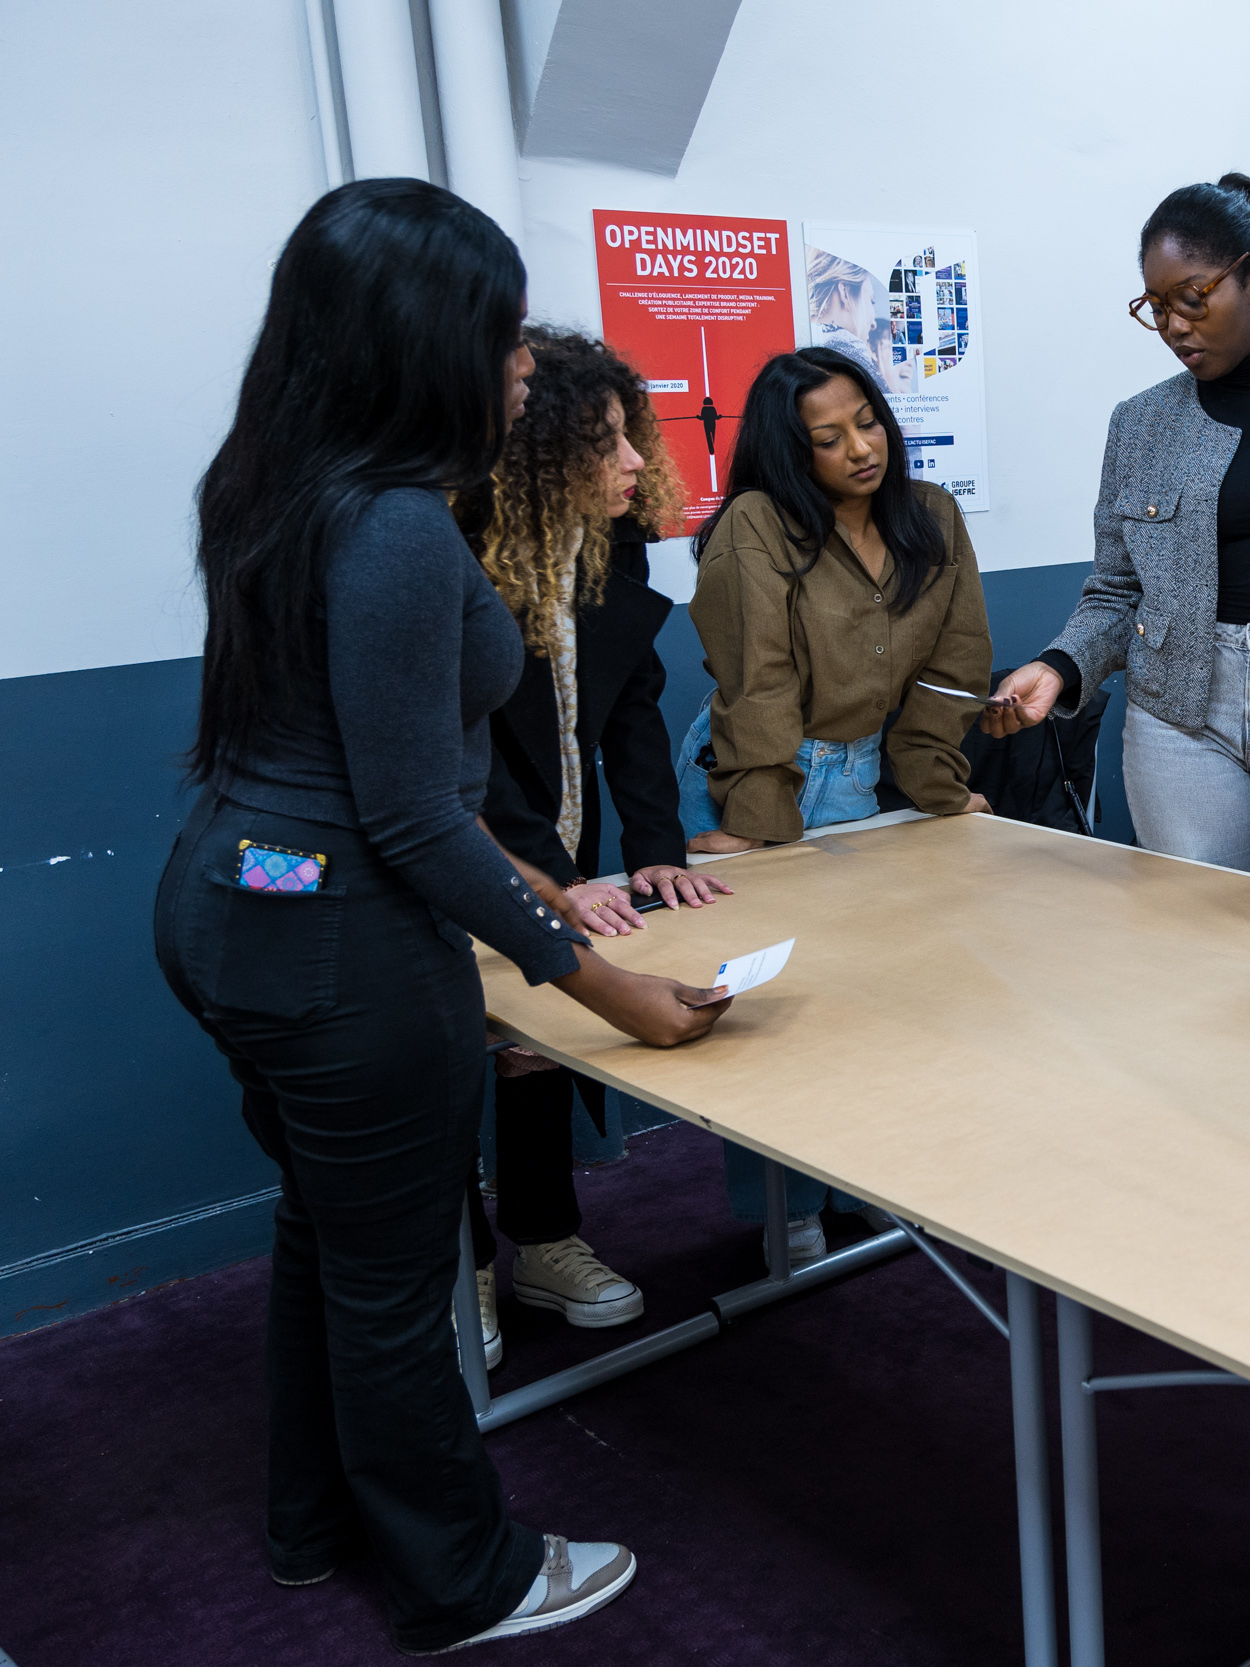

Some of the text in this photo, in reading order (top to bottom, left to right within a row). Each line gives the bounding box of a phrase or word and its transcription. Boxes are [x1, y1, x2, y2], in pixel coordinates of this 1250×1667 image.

[605, 224, 780, 255] OPENMINDSET
[635, 253, 758, 280] DAYS 2020
[650, 382, 669, 390] janvier
[906, 394, 949, 403] conférences
[904, 405, 940, 413] interviews
[951, 480, 976, 488] GROUPE
[951, 488, 976, 496] ISEFAC
